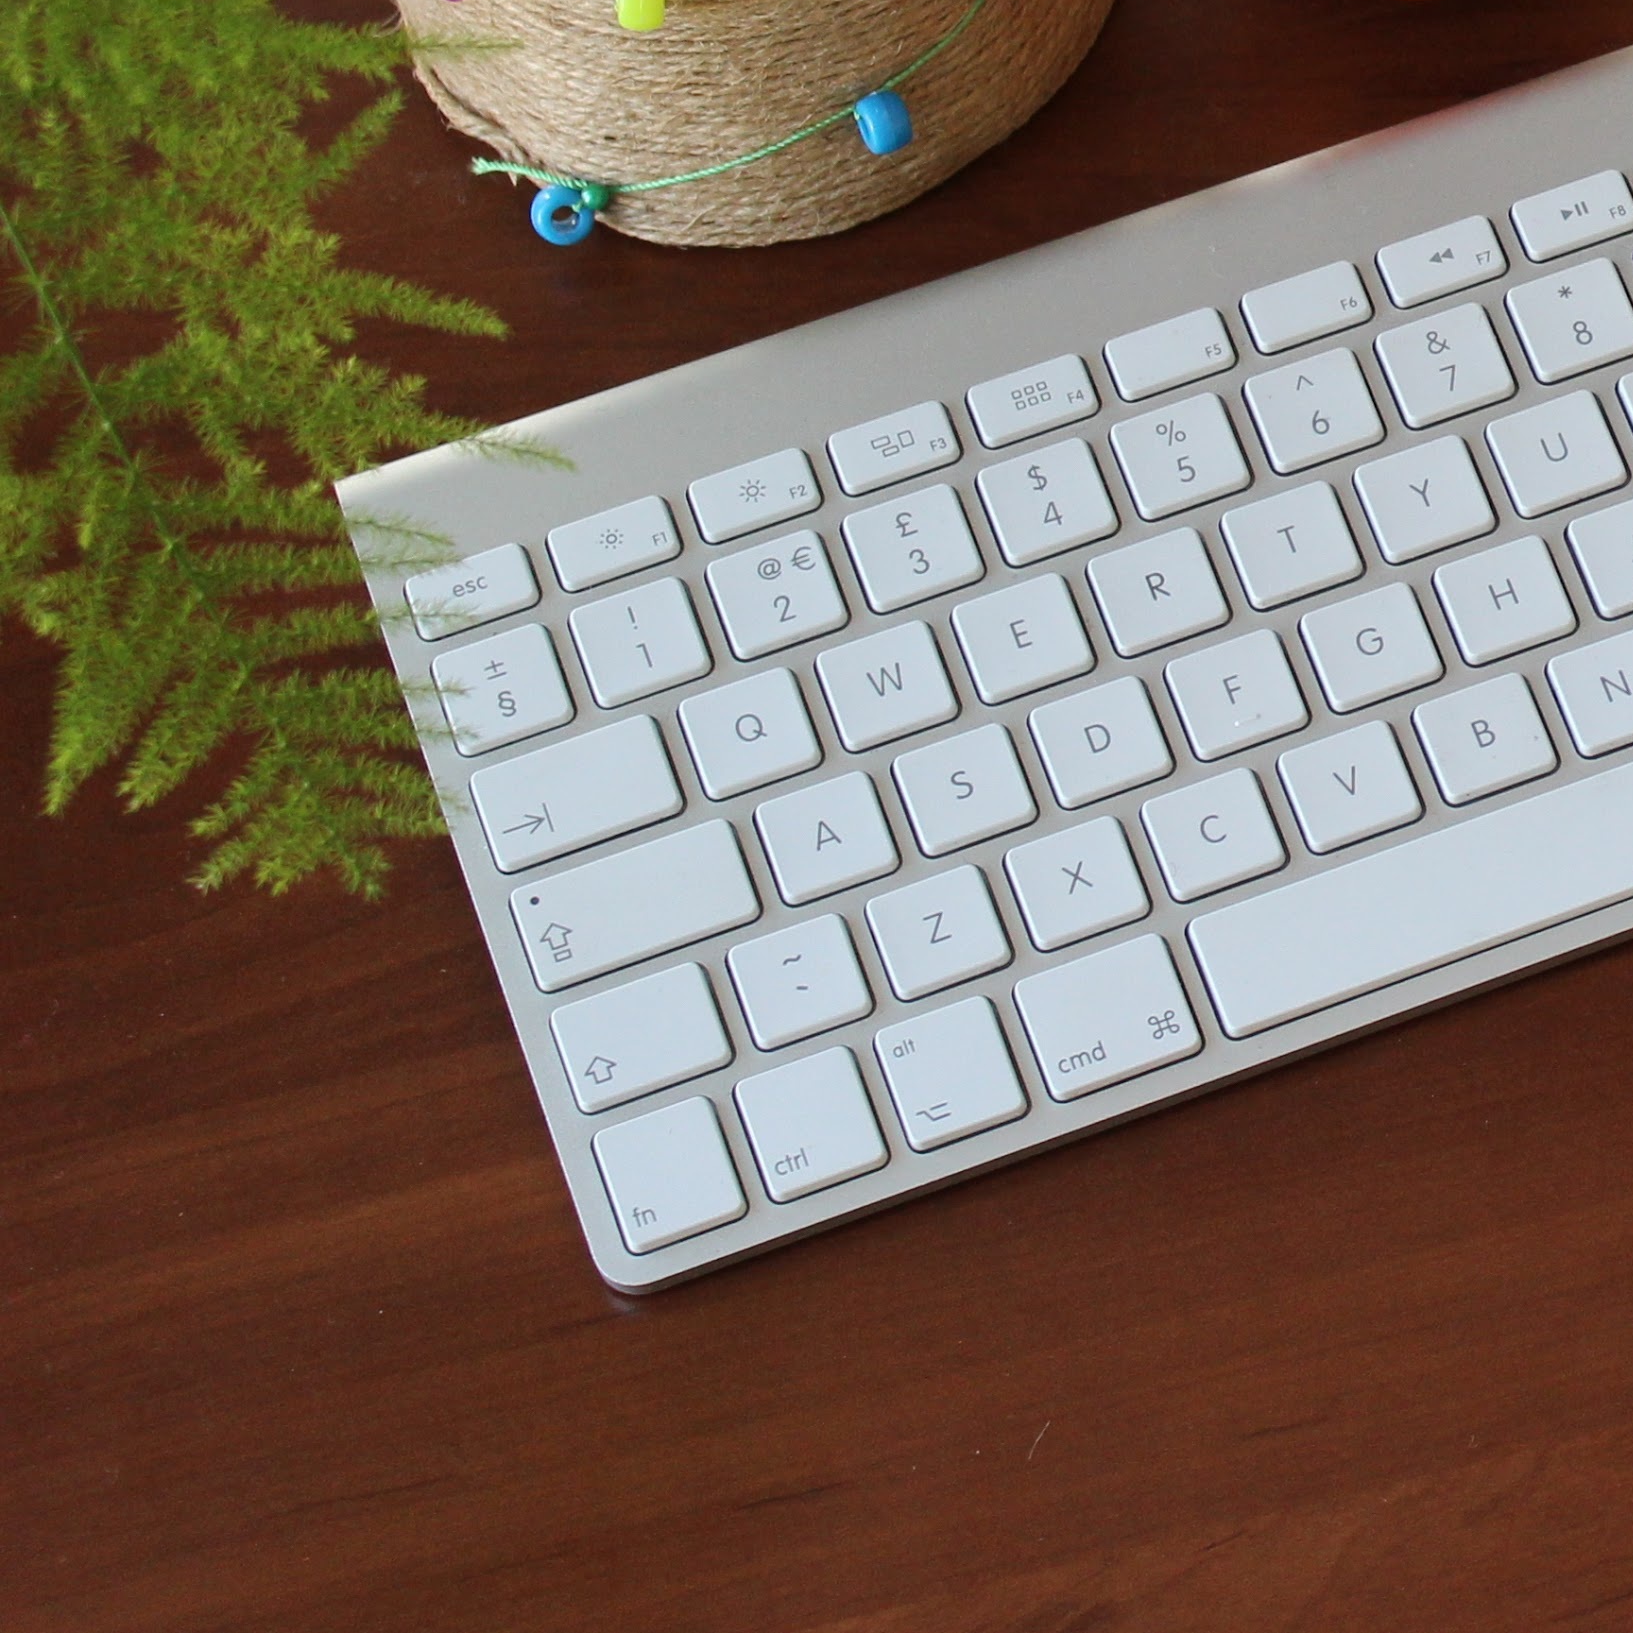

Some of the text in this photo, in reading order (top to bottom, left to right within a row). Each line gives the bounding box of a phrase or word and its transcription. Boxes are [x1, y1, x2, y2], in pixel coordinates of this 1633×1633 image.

[1609, 205, 1626, 218] F8
[1476, 251, 1490, 264] F7
[1340, 297, 1357, 310] F6
[1573, 321, 1592, 345] 8
[1205, 344, 1221, 357] F5
[1067, 390, 1084, 403] F4
[1312, 410, 1329, 434] 6
[930, 438, 947, 451] F3
[1541, 433, 1568, 462] U
[1177, 456, 1195, 482] 5
[789, 485, 807, 498] F2
[1044, 502, 1062, 525] 4
[652, 532, 667, 545] F1
[909, 549, 929, 574] 3
[453, 576, 487, 597] esc
[1146, 573, 1170, 600] R
[774, 596, 796, 622] 2
[1010, 620, 1032, 648] E
[1356, 628, 1383, 655] G
[867, 663, 902, 696] W
[1223, 675, 1240, 704] F
[736, 714, 767, 741] Q
[1084, 724, 1110, 753] D
[1471, 720, 1495, 748] B
[951, 771, 973, 799] S
[817, 821, 841, 851] A
[1200, 815, 1226, 843] C
[923, 912, 952, 944] Z
[893, 1039, 915, 1057] alt
[1059, 1041, 1106, 1073] cmd
[775, 1148, 808, 1175] ctrl
[633, 1207, 656, 1227] fn
